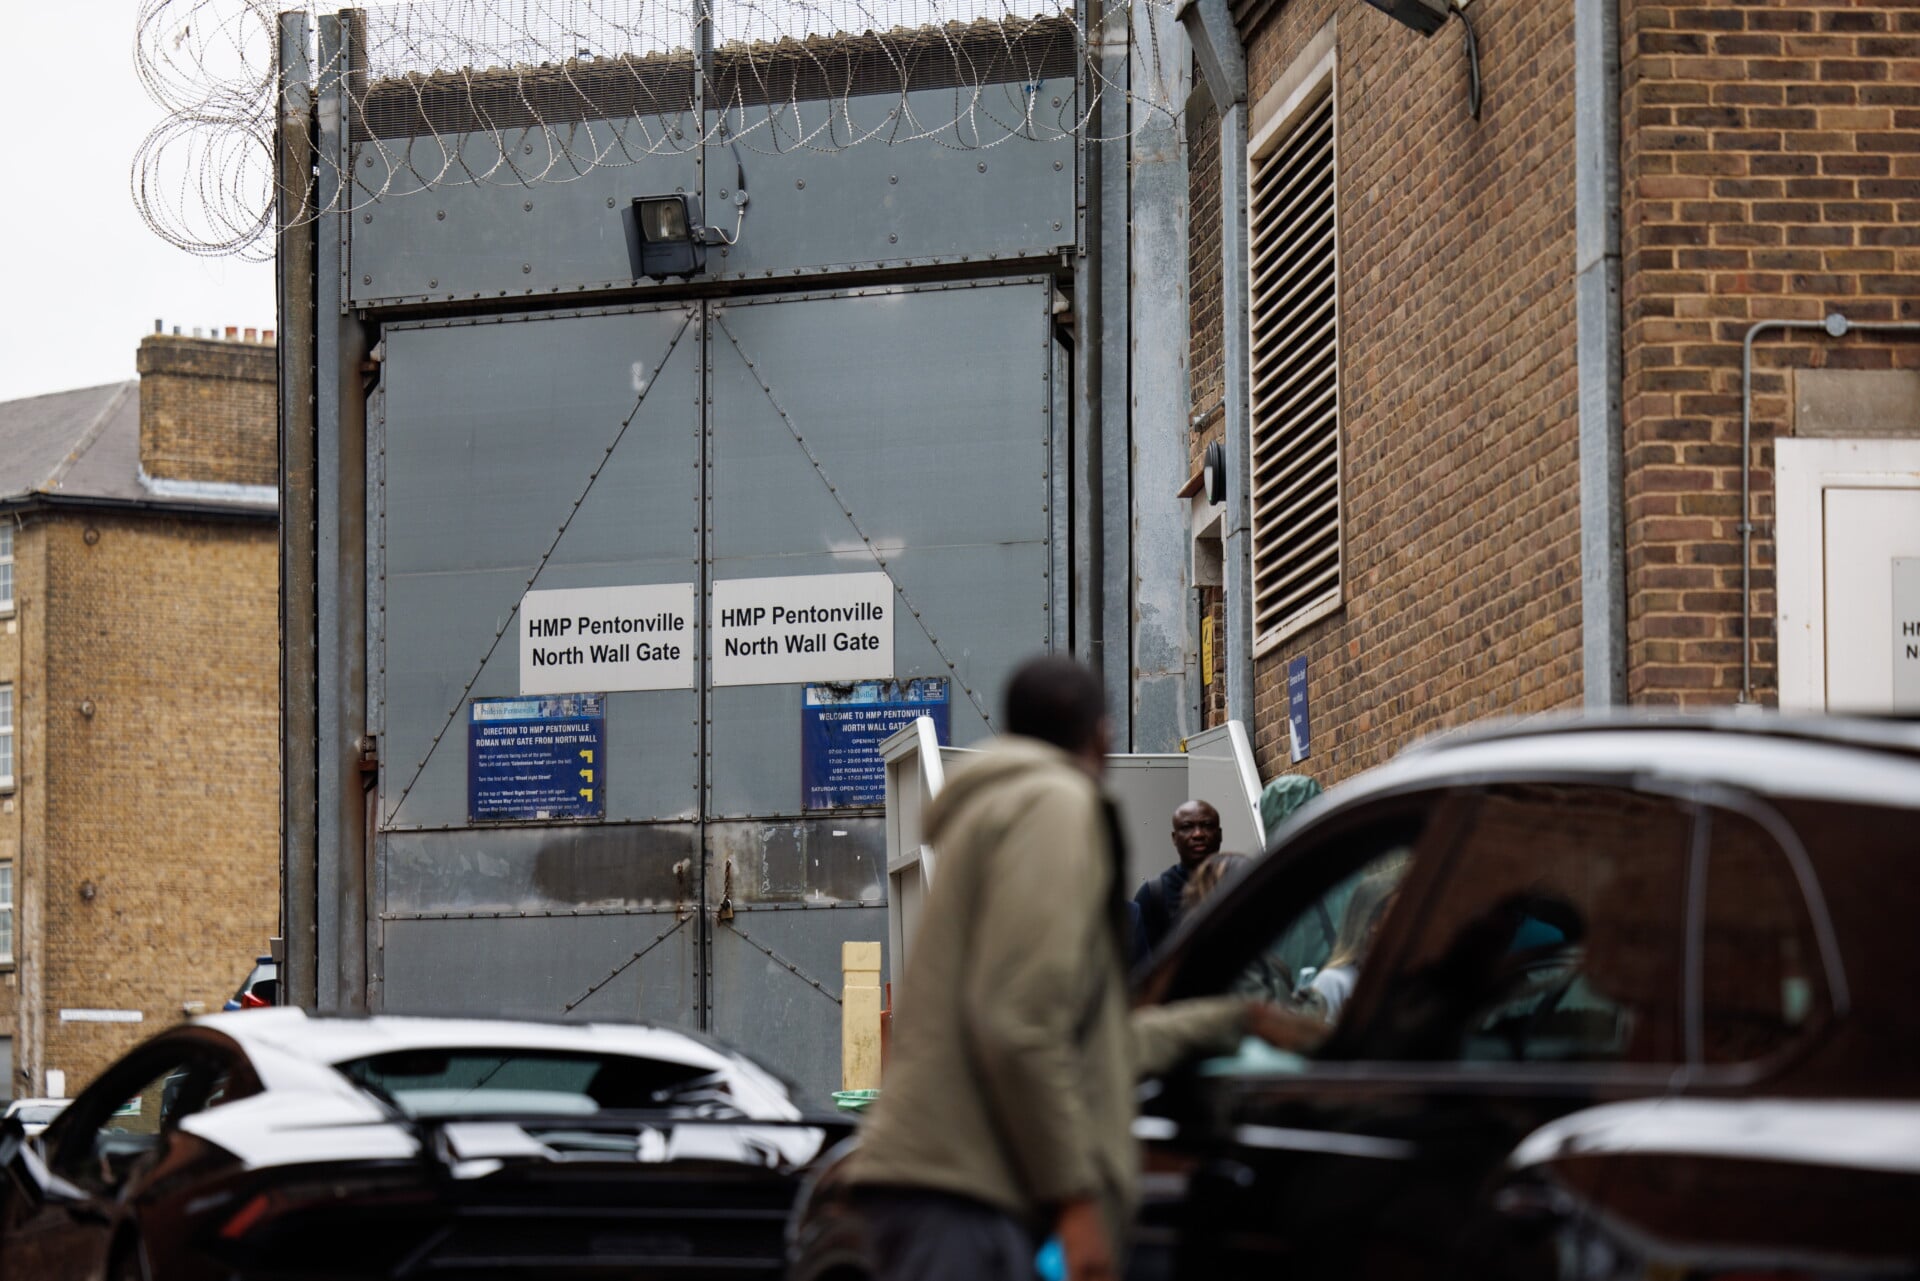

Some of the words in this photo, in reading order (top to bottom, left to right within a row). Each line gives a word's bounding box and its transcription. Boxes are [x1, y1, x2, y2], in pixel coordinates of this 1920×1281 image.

[722, 608, 765, 627] HMP
[773, 602, 883, 624] Pentonville
[530, 618, 571, 637] HMP
[579, 613, 684, 635] Pentonville
[726, 636, 778, 656] North
[785, 634, 825, 653] Wall
[834, 633, 879, 651] Gate
[533, 647, 583, 666] North
[590, 644, 629, 663] Wall
[637, 643, 680, 661] Gate
[819, 712, 853, 720] WELCOME
[855, 711, 863, 719] TO
[866, 710, 881, 719] HMP
[884, 709, 931, 718] PENTONVILLE
[484, 727, 517, 735] DIRECTION
[519, 726, 528, 734] TO
[530, 725, 544, 734] HMP
[545, 723, 590, 733] PENTONVILLE
[842, 723, 866, 732] NORTH
[867, 722, 886, 731] WALL
[476, 738, 500, 747] ROMAN
[500, 738, 515, 746] WAY
[516, 737, 533, 746] GATE
[534, 736, 553, 745] FROM
[555, 735, 577, 744] NORTH
[578, 734, 597, 743] WALL
